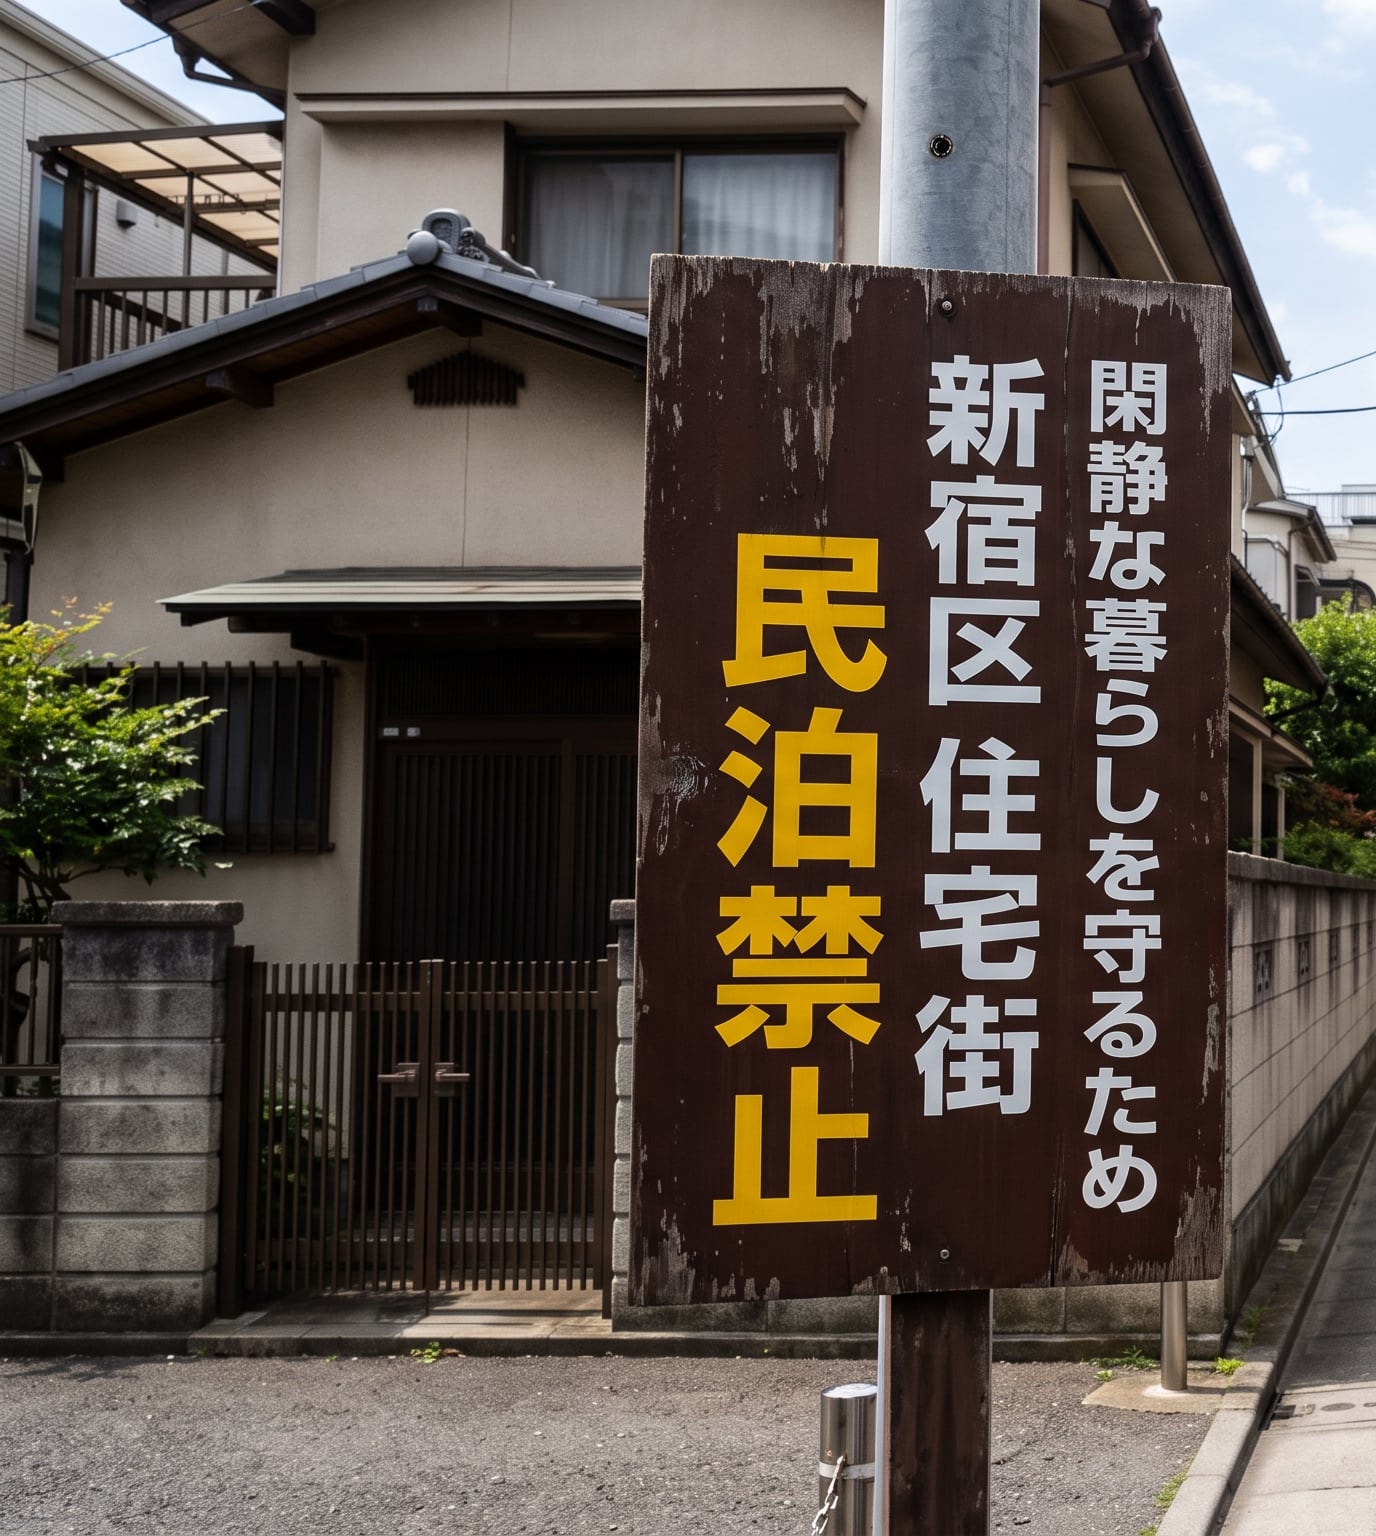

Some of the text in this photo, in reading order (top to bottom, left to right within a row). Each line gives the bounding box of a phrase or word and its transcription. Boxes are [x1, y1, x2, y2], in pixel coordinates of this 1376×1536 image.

[712, 532, 888, 1226] 民泊禁止
[1082, 359, 1169, 1214] 閑静な暮らしを守るため
